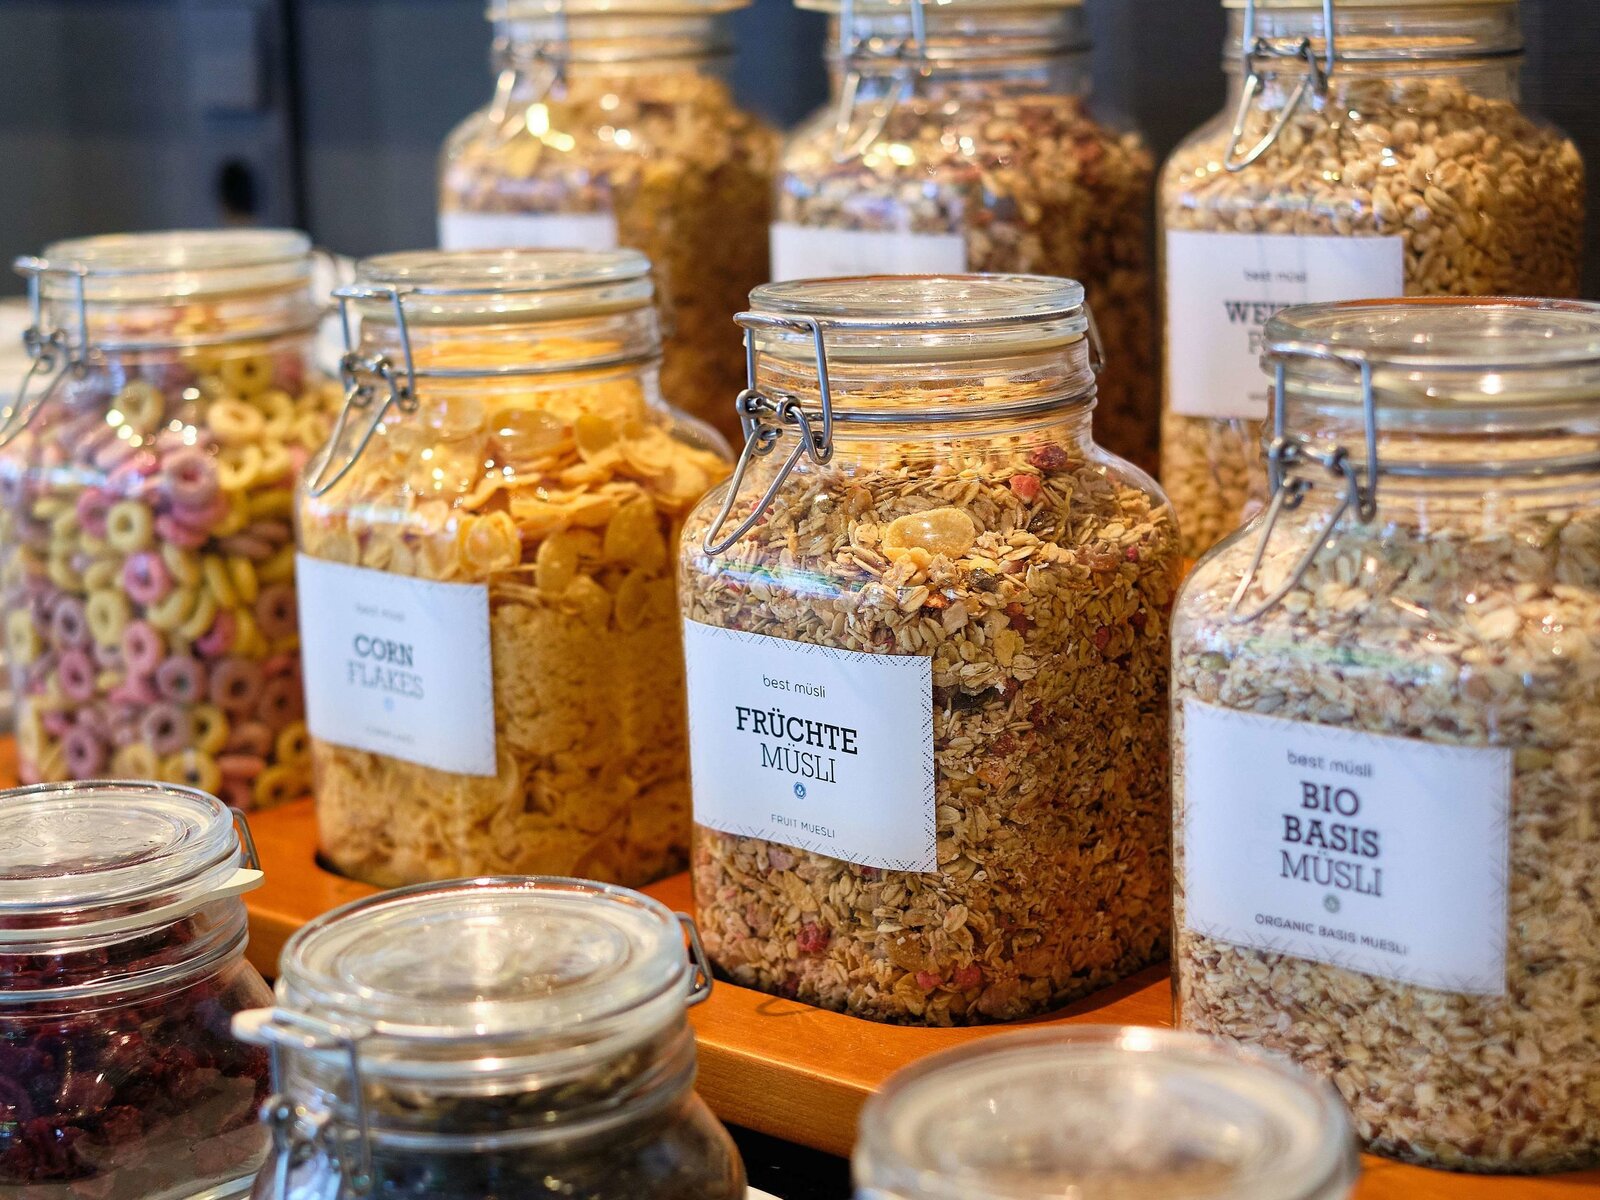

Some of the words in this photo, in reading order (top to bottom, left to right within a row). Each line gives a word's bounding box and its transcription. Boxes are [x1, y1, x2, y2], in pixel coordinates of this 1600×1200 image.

[354, 633, 414, 667] CORN
[347, 659, 424, 699] FLAKES
[763, 674, 790, 691] best
[794, 682, 826, 698] müsli
[735, 705, 858, 755] FRÜCHTE
[760, 742, 837, 784] MÜSLI
[1287, 749, 1323, 768] best
[1330, 760, 1373, 778] müsli
[1300, 780, 1361, 817] BIO
[771, 814, 797, 829] FRUIT
[801, 822, 836, 839] MUESLI
[1282, 813, 1380, 858] BASIS
[1280, 849, 1383, 897] MÜSLI
[1255, 913, 1314, 935] ORGANIC
[1318, 925, 1357, 944] BASIS
[1360, 935, 1408, 955] MUESLI
